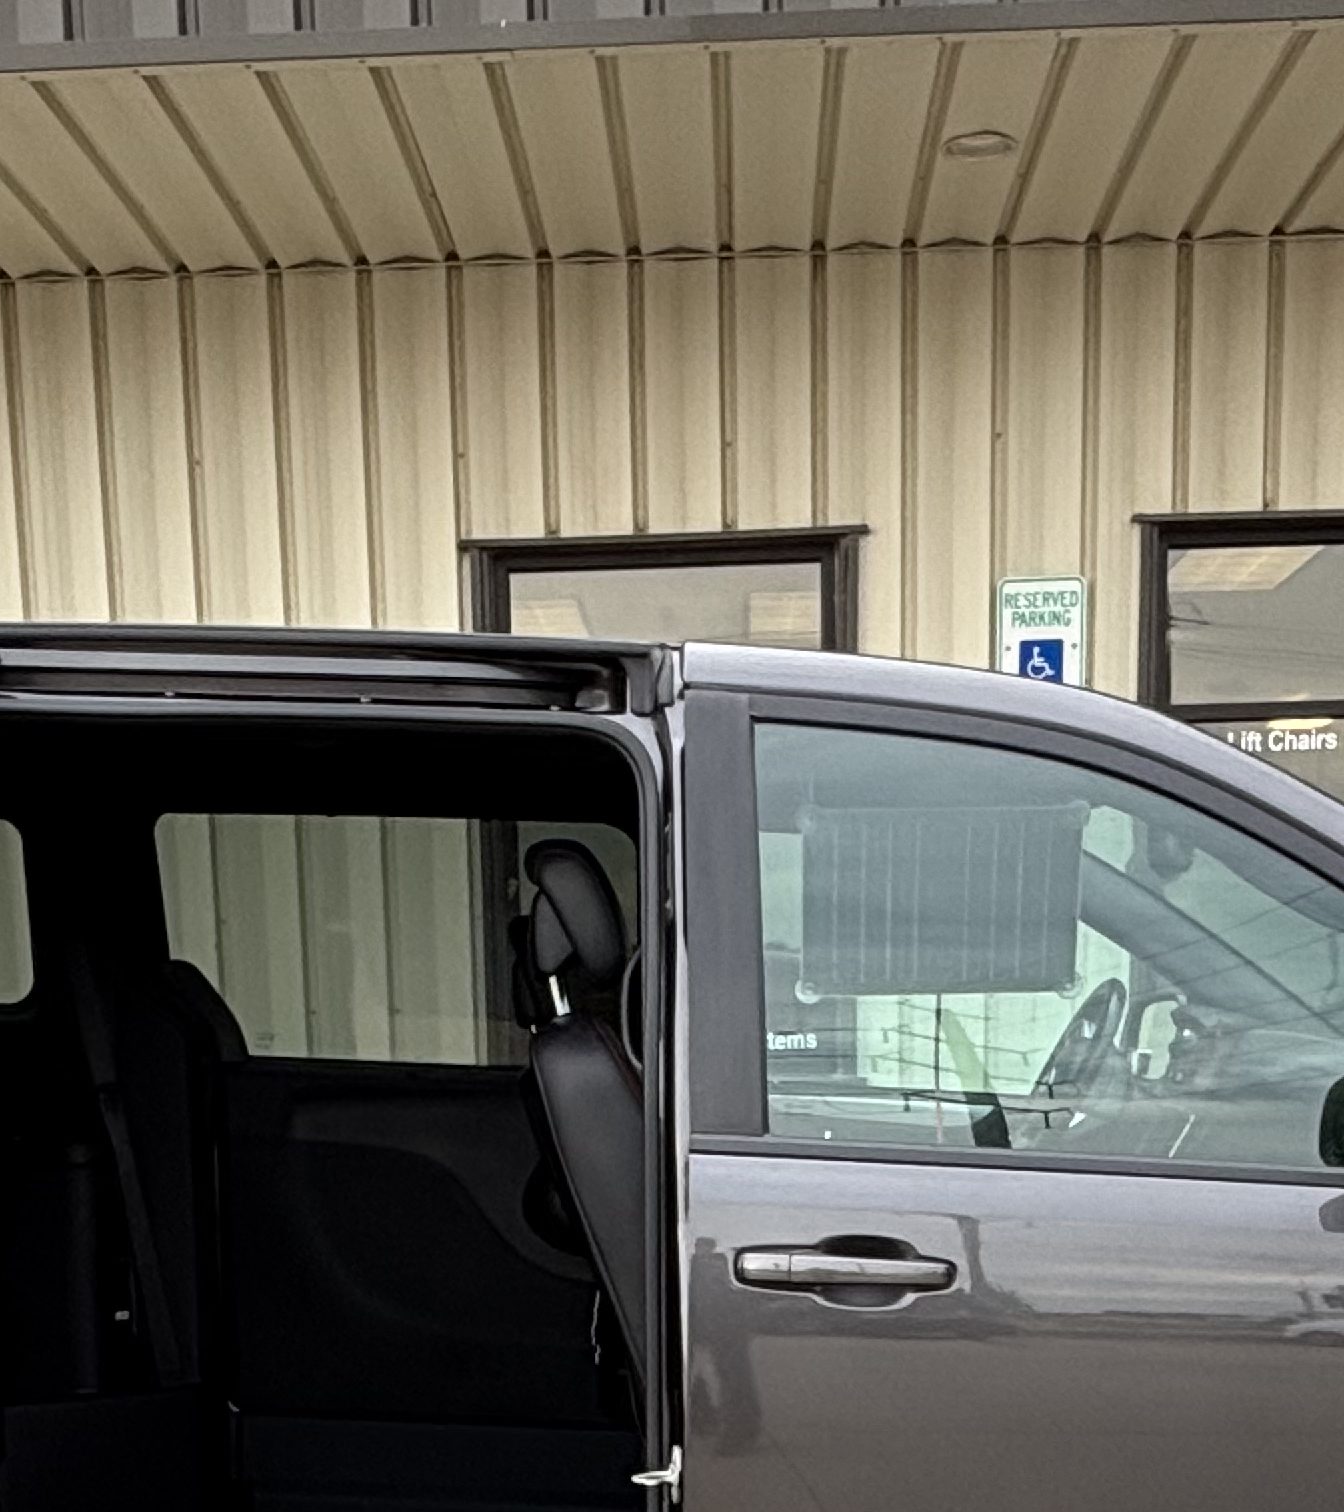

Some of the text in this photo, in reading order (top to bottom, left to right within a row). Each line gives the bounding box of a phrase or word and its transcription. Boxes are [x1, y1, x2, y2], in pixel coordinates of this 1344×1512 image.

[1004, 590, 1079, 609] RESERVED
[1011, 608, 1072, 628] PARKING
[1268, 728, 1338, 752] Chairs
[766, 1032, 817, 1050] tems
